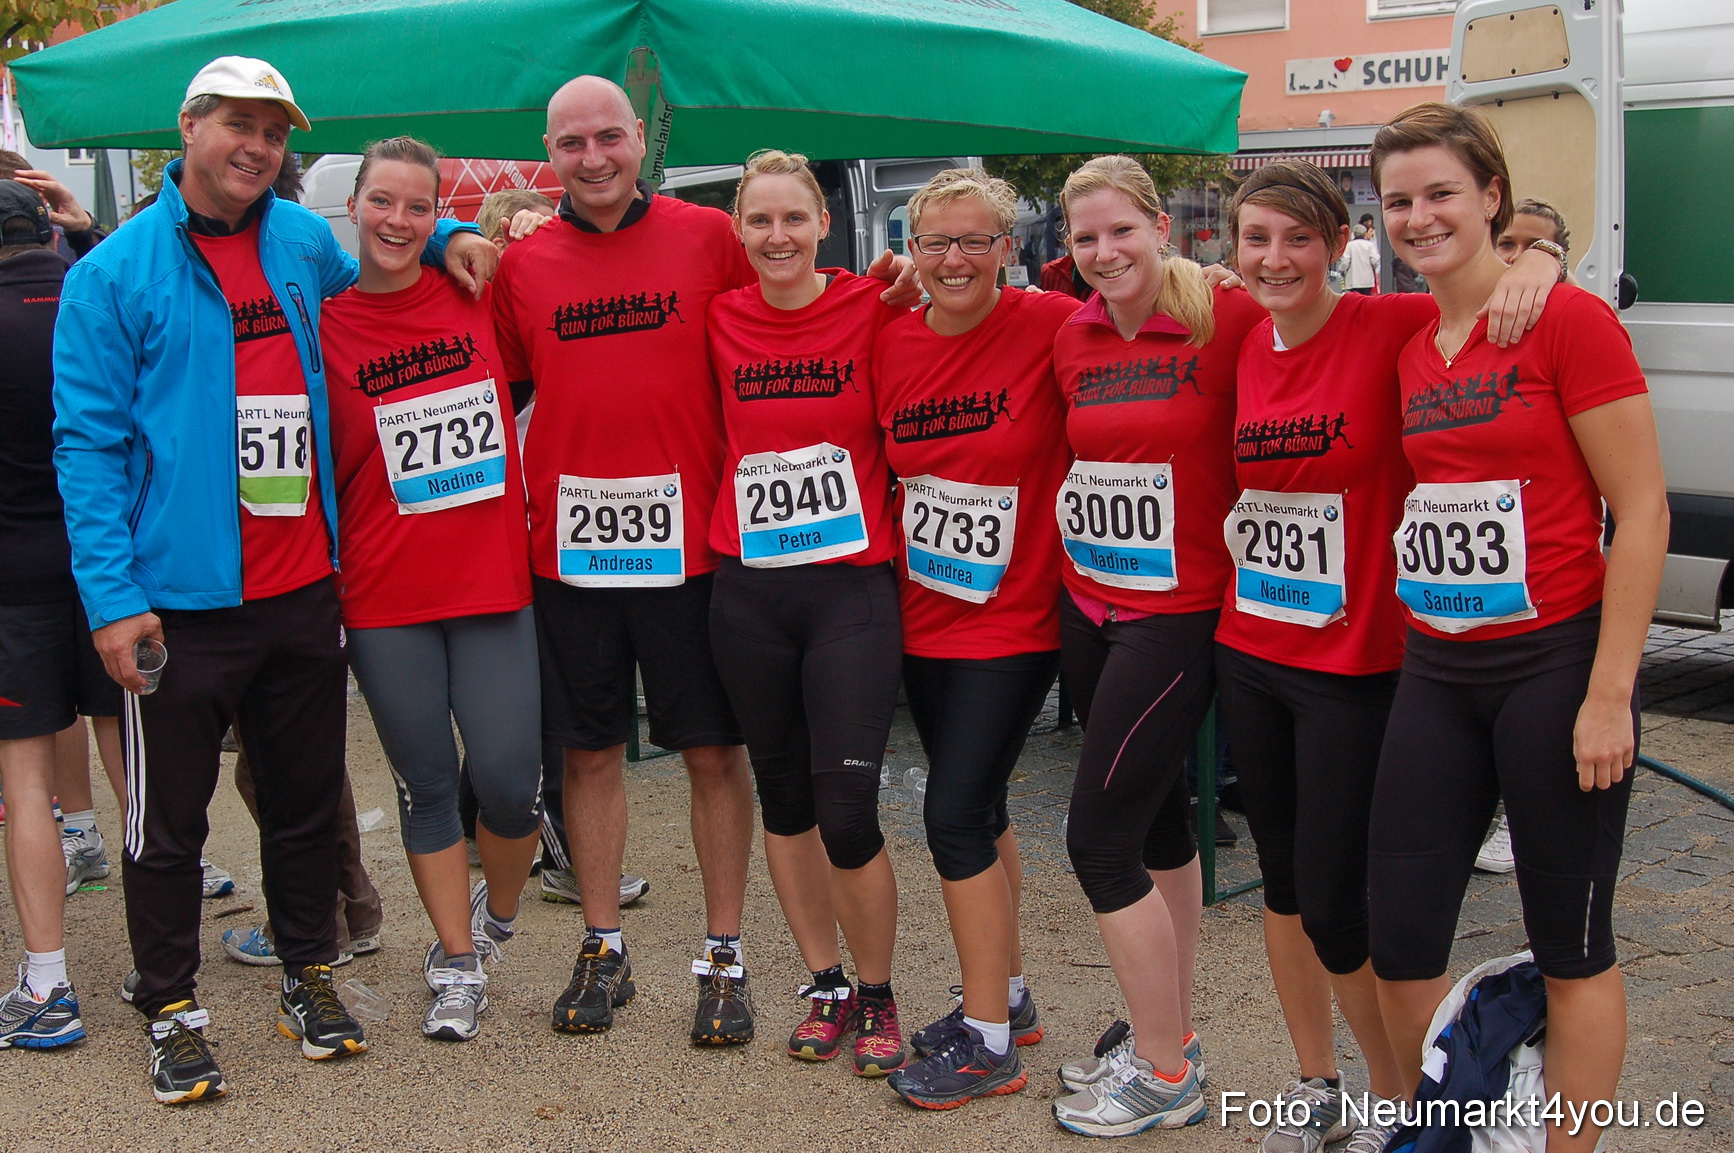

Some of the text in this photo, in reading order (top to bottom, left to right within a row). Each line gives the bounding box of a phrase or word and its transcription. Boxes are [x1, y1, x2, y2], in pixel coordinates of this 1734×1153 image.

[253, 314, 289, 334] BÜRN
[560, 310, 660, 336] RUN FOR BÜRNI
[366, 352, 466, 393] RUN FOR BÜRNI
[738, 376, 835, 396] RUN FOR BÜRNI
[1102, 379, 1129, 400] FOR
[1129, 376, 1173, 396] BÜRNI
[379, 396, 480, 428] PARTL Neumarkt
[896, 410, 989, 438] RUN FOR BÜRNI
[1424, 402, 1448, 427] FOR
[1450, 396, 1494, 421] BÜRNI
[394, 410, 500, 473] 2732
[1237, 434, 1324, 457] RUN FOR BÜRNI
[736, 456, 828, 478] PARTL Neumarkt
[428, 470, 485, 495] Nadine
[560, 486, 658, 500] PARTL Neumarkt
[1089, 475, 1148, 487] Neumarkt
[746, 470, 847, 525] 2940
[906, 482, 993, 508] PARTL Neumarkt
[1423, 499, 1490, 513] Neumarkt
[569, 502, 672, 543] 2939
[1064, 490, 1161, 541] 3000
[1263, 502, 1319, 519] Neumarkt
[778, 531, 822, 550] Petra
[912, 501, 1001, 558] 2733
[1237, 519, 1328, 575] 2931
[1402, 520, 1509, 576] 3033
[588, 555, 653, 571] Andreas
[927, 559, 972, 584] Andrea
[1089, 549, 1139, 571] Nadine
[1260, 579, 1310, 606] Nadine
[1423, 589, 1484, 612] Sandra
[843, 759, 873, 768] CRAFT
